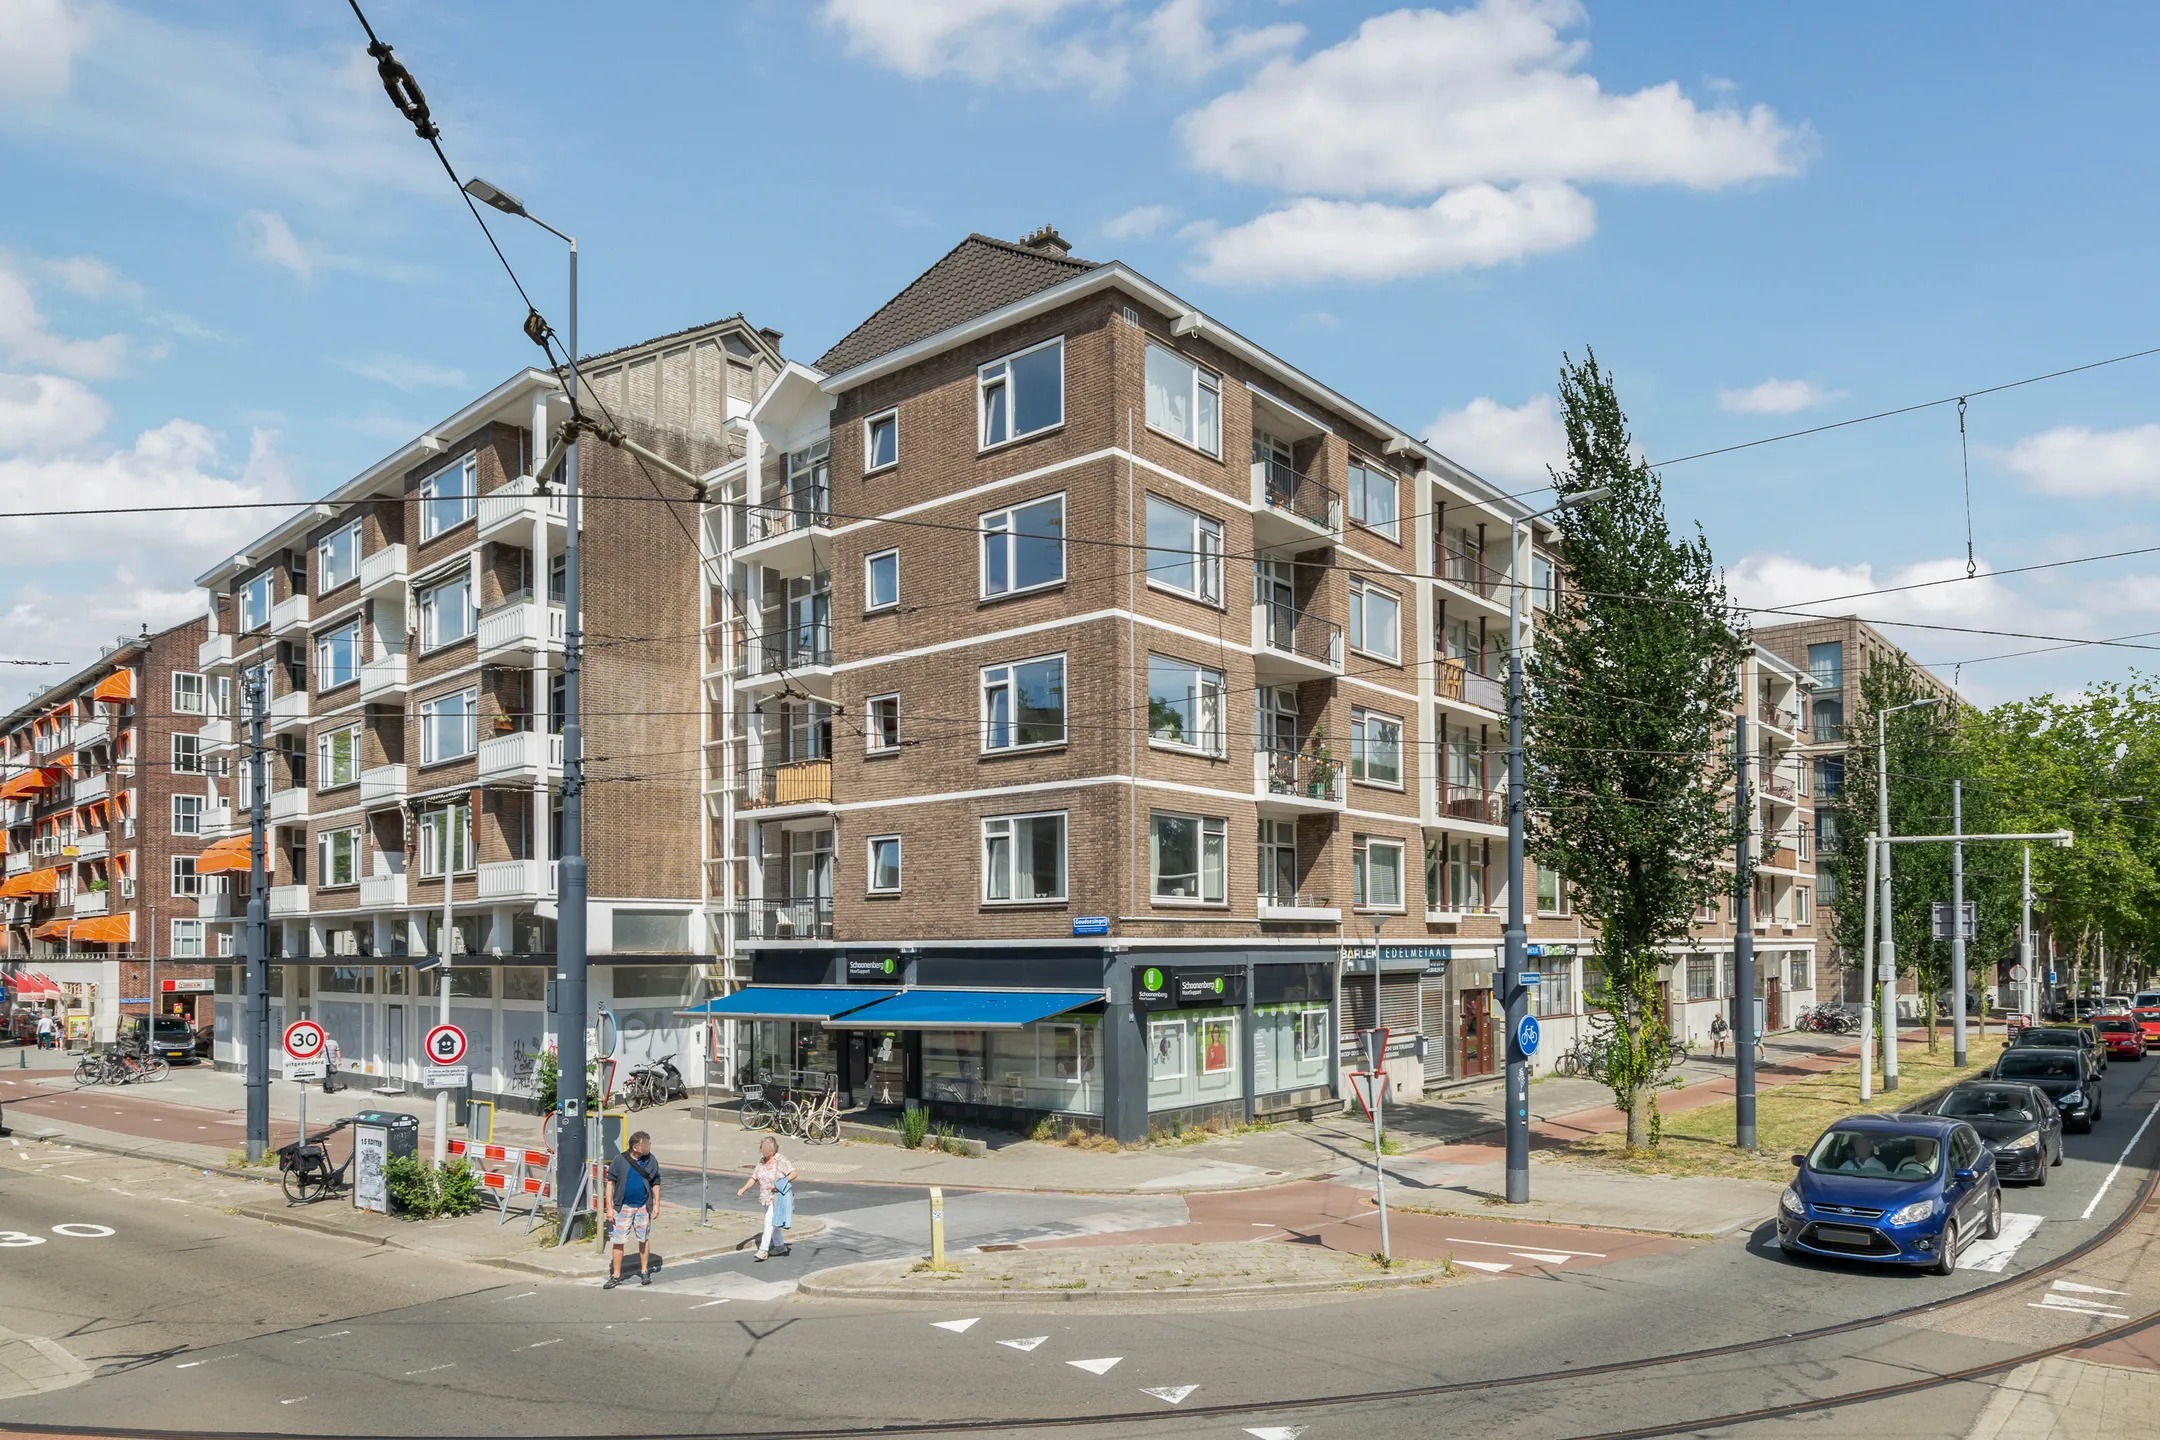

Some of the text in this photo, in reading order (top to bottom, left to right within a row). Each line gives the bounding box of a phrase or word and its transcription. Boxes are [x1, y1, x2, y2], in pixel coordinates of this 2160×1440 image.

[1385, 948, 1447, 958] EDELMETAAL
[850, 961, 884, 970] Schoonenberg
[1182, 981, 1214, 990] Schoonenberg
[292, 1032, 318, 1047] 30
